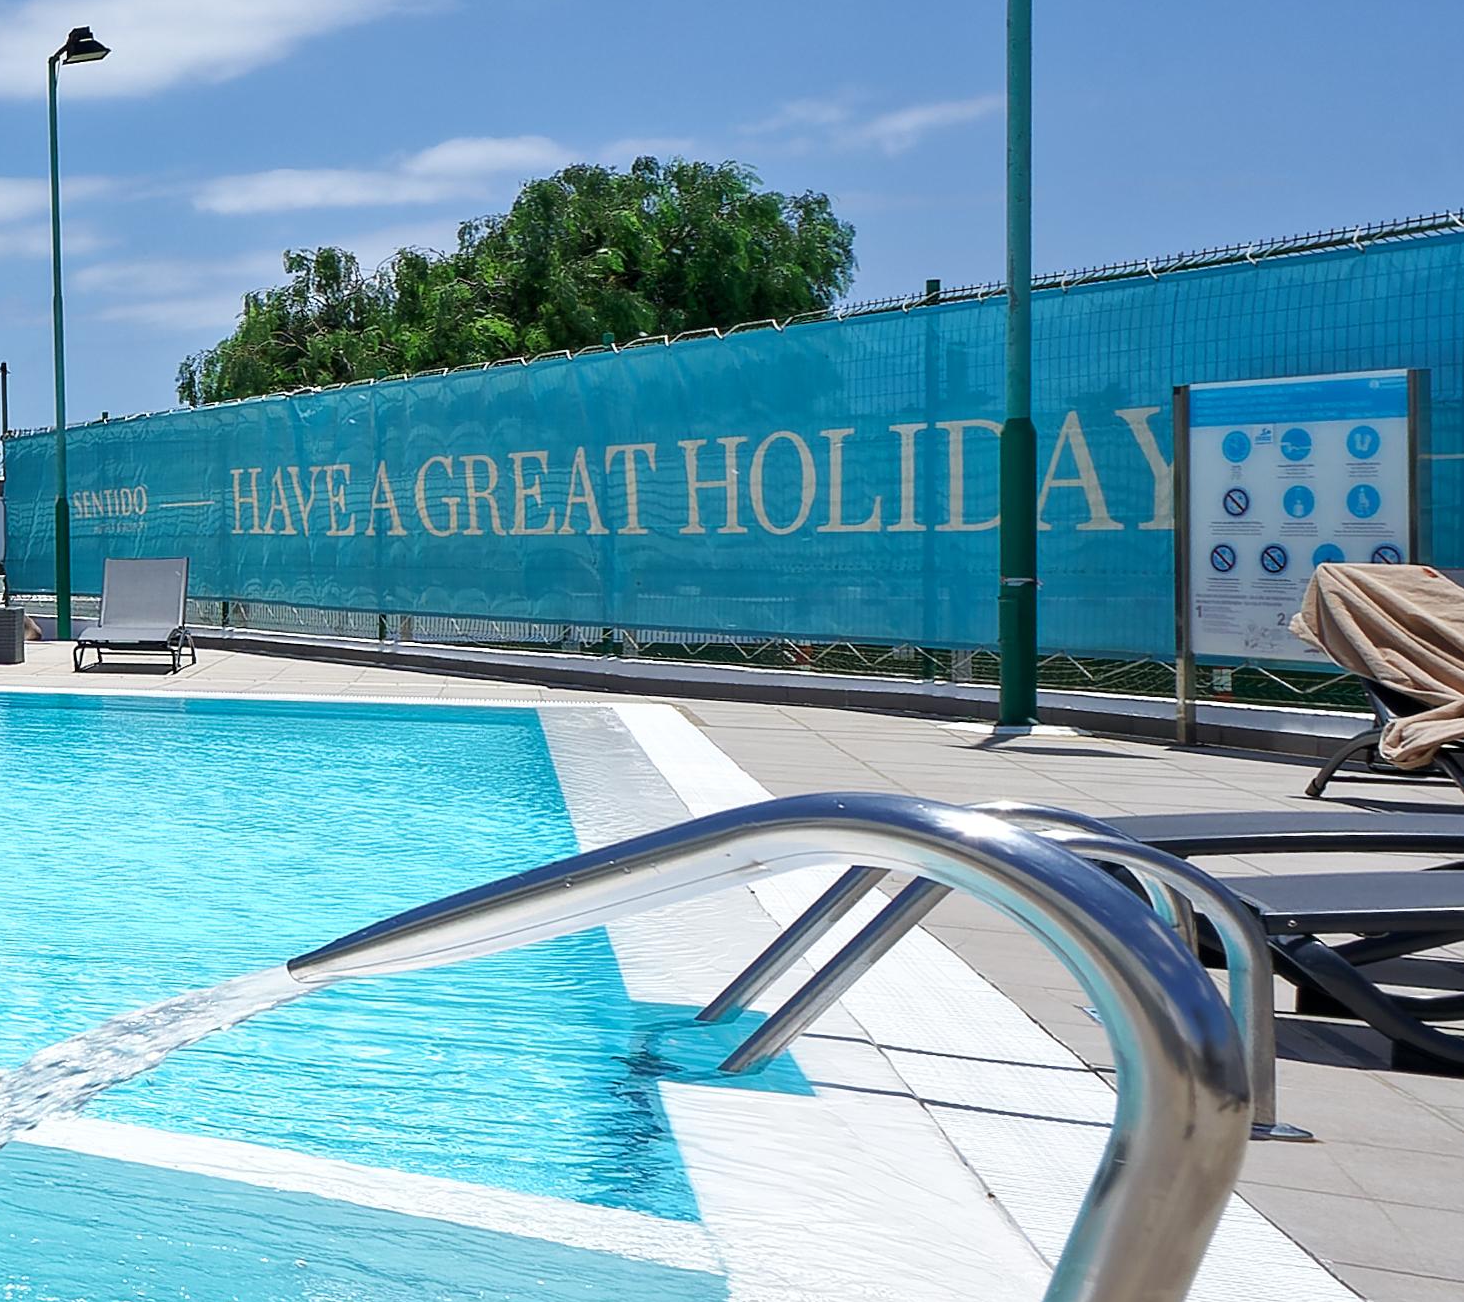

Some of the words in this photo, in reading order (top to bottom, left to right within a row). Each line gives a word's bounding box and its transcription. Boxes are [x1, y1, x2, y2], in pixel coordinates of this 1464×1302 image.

[230, 463, 356, 537] HAVE
[366, 460, 407, 536] A
[414, 442, 657, 537] GREAT
[678, 406, 1175, 535] HOLIDAY
[72, 486, 147, 518] SENTIDO
[1195, 605, 1203, 618] 1
[1277, 612, 1286, 626] 2
